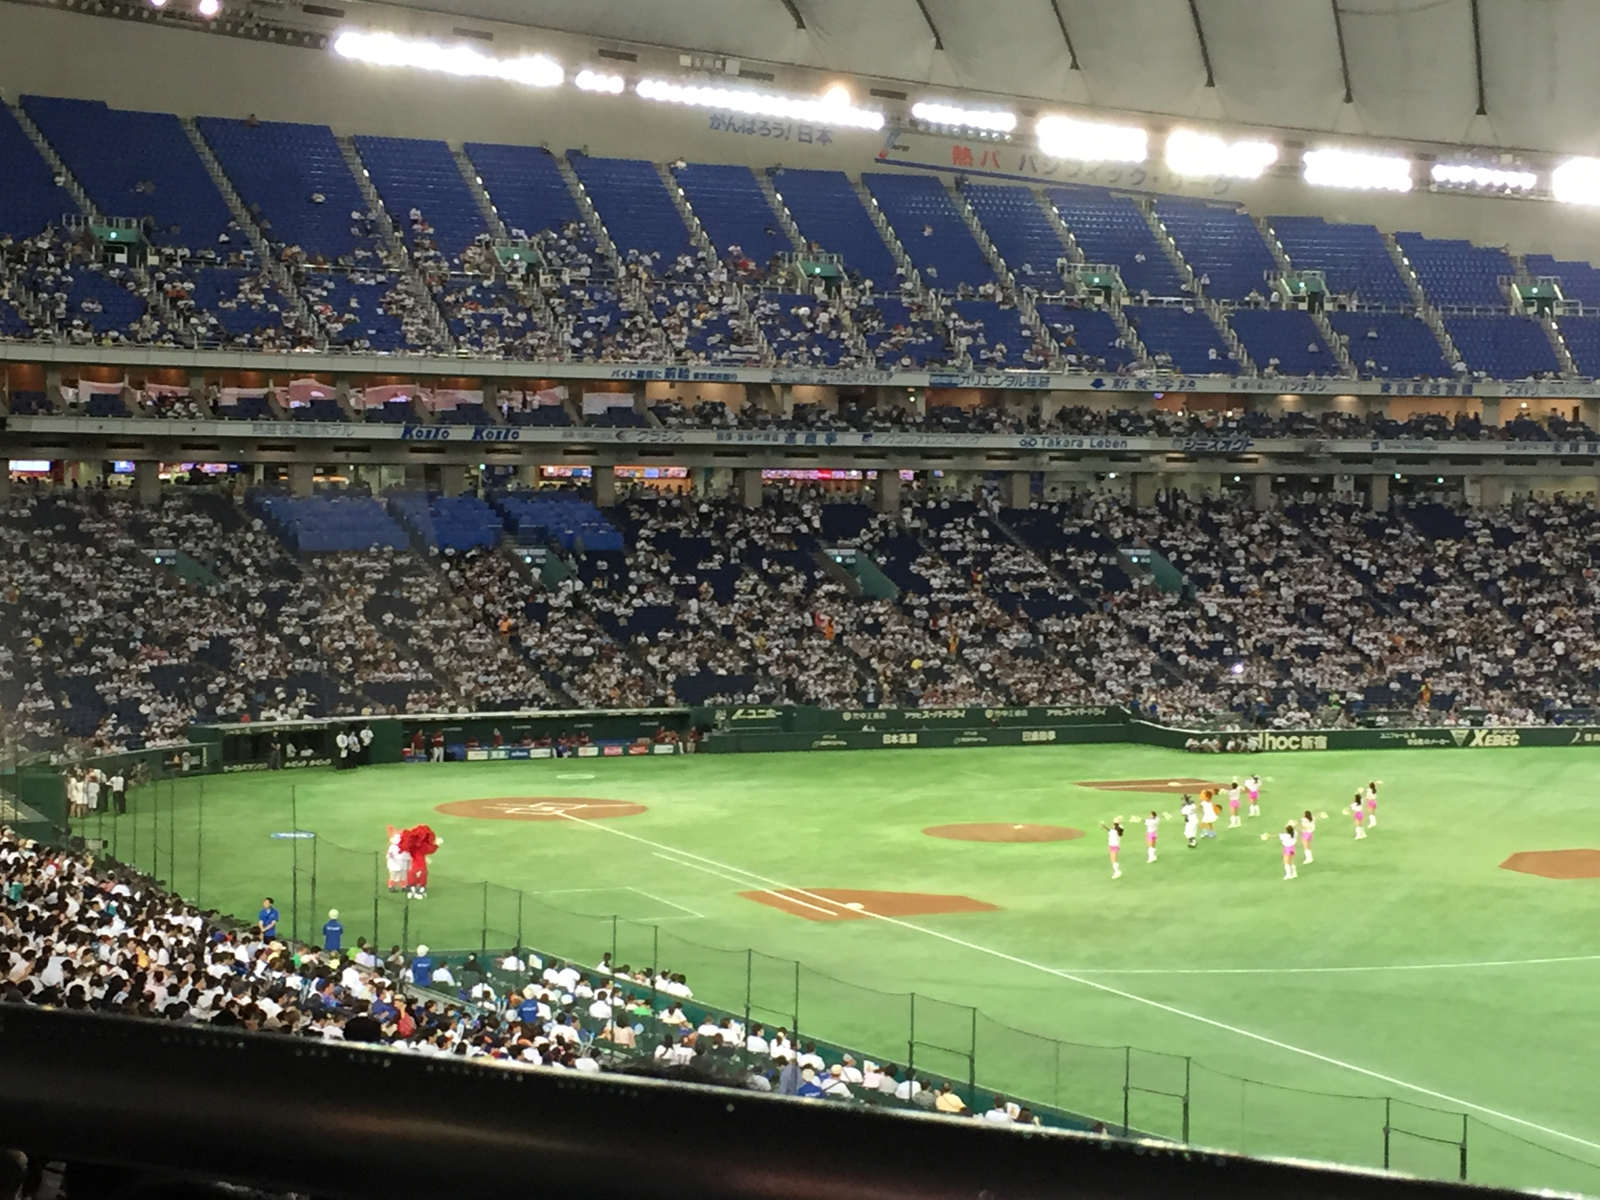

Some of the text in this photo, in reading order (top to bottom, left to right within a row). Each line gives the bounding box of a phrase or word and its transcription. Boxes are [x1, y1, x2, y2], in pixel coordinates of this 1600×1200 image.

[1040, 437, 1128, 449] Takara Leben
[1469, 729, 1520, 747] XEBEC
